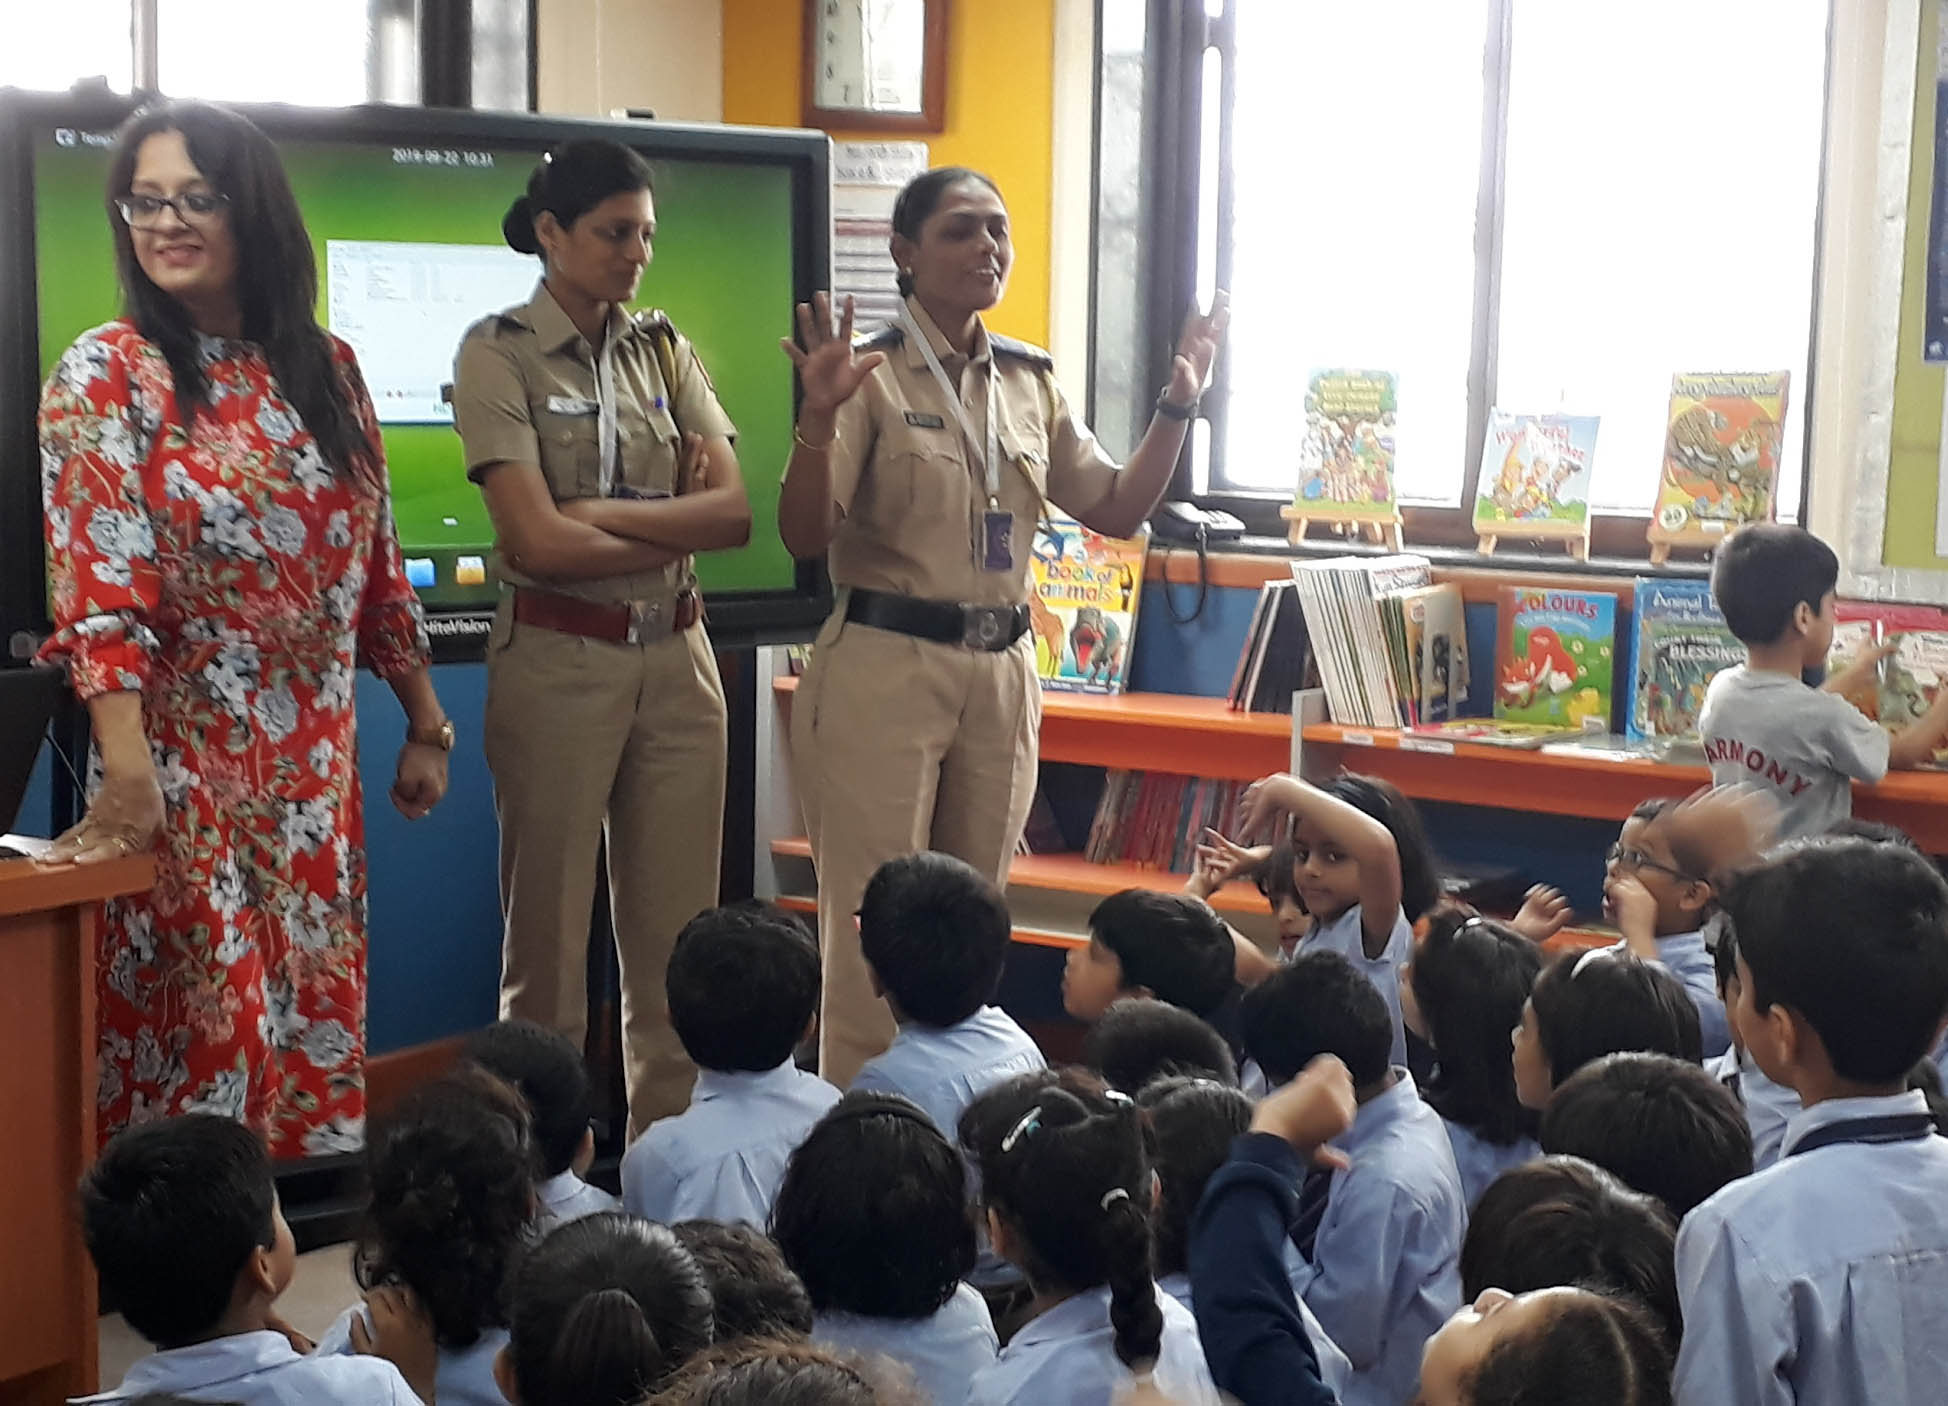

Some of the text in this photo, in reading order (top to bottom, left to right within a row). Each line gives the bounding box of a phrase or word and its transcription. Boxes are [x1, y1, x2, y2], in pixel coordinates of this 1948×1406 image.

[1047, 559, 1115, 585] book of
[1039, 581, 1114, 601] animals
[1653, 589, 1702, 610] Animal
